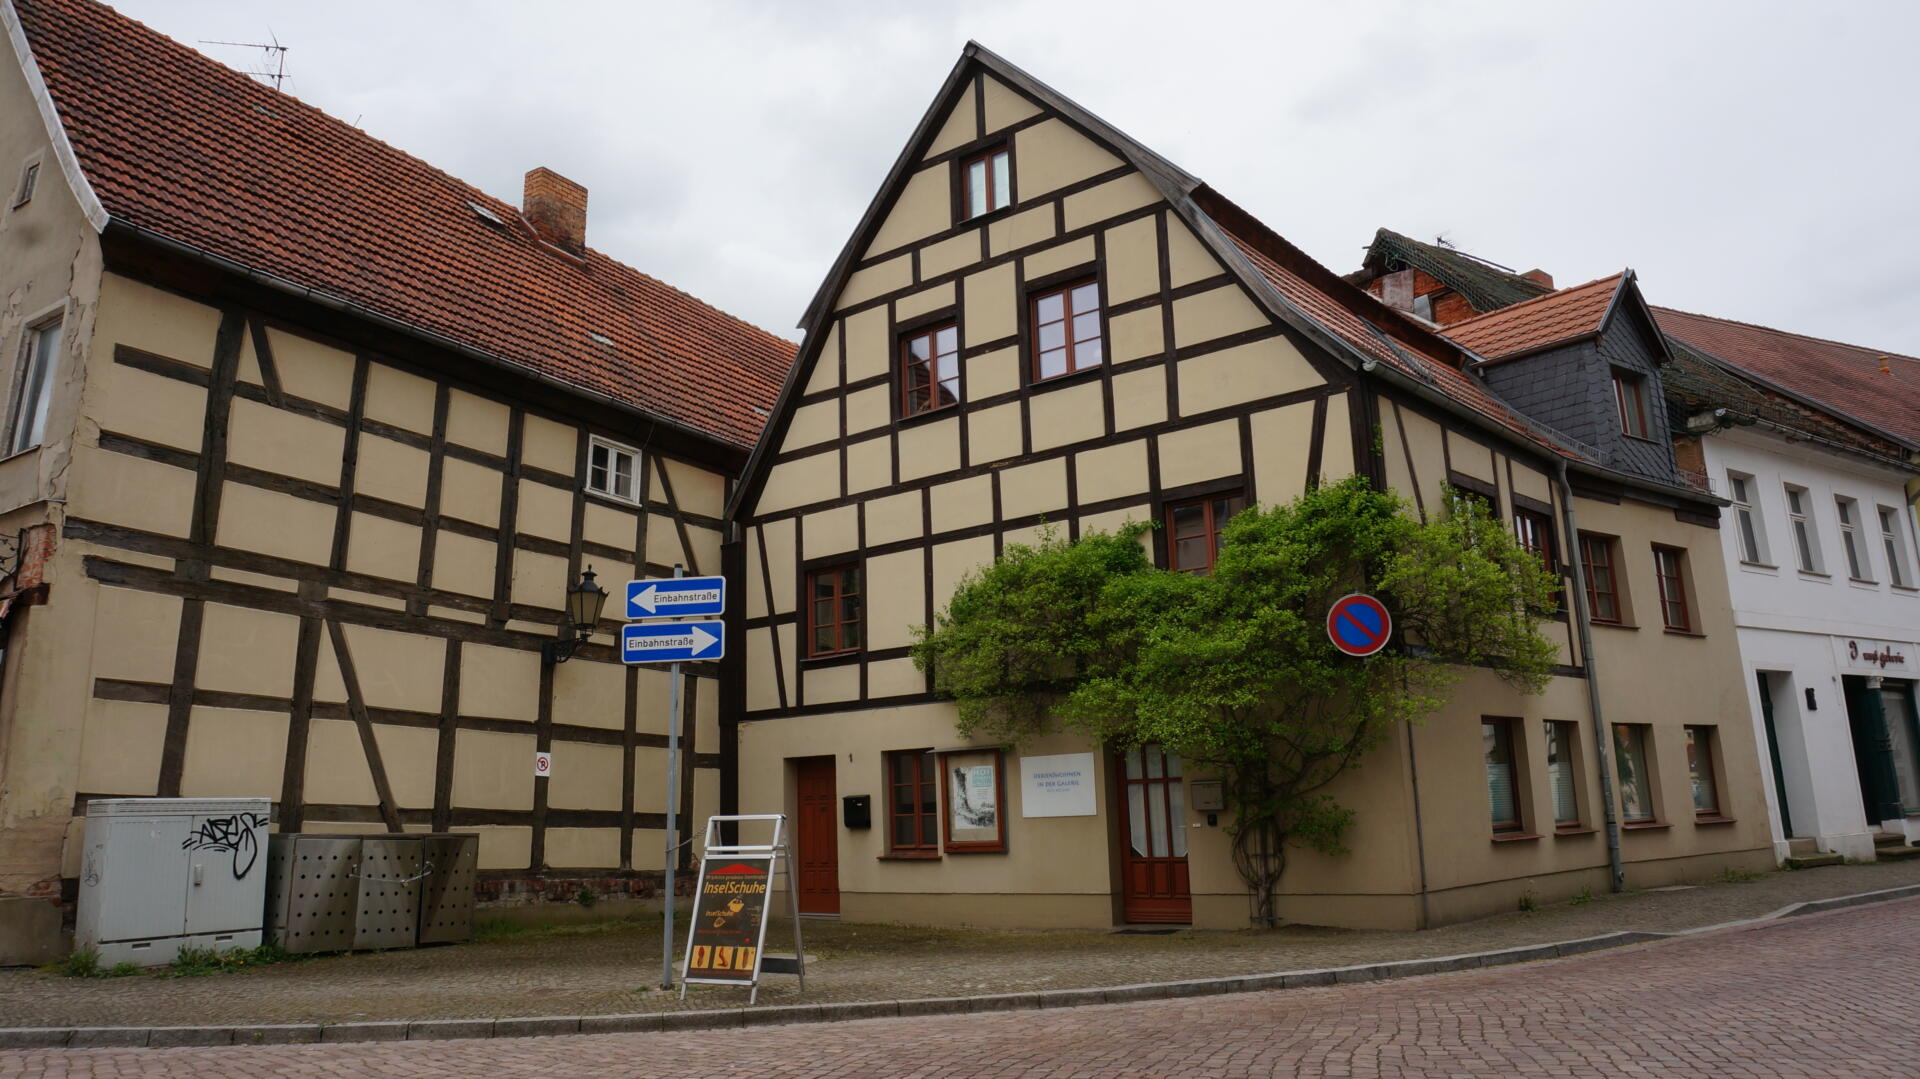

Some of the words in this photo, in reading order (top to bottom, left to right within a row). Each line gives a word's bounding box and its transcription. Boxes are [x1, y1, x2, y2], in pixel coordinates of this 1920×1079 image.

[654, 593, 717, 603] Einbahnstraße
[629, 637, 694, 648] Einbahnstraße
[704, 881, 766, 894] InselSchuhe
